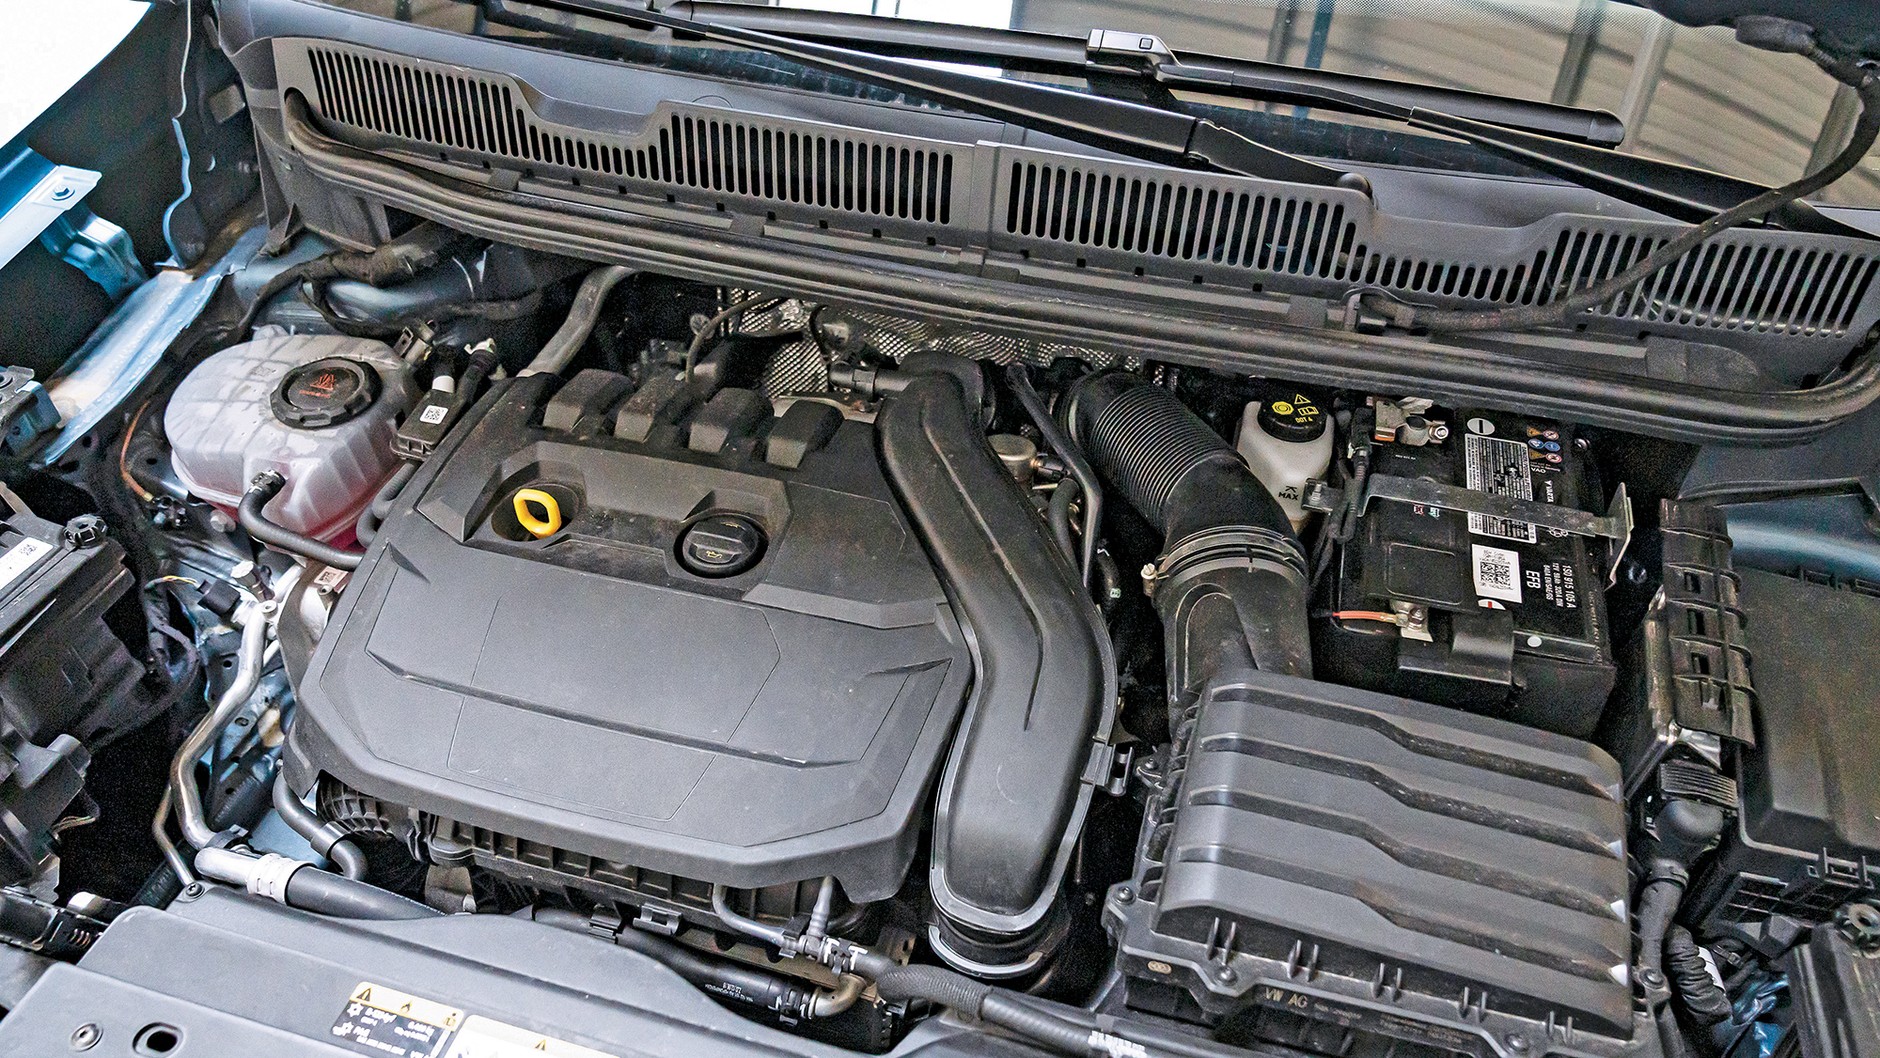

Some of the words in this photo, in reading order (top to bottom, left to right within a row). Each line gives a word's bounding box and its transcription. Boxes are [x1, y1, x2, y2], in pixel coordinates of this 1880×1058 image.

[1278, 491, 1298, 500] MAX
[1526, 570, 1541, 589] EFB
[1563, 577, 1574, 589] 915
[1565, 590, 1576, 602] 105
[1265, 987, 1284, 1001] VW
[1288, 994, 1308, 1008] AG
